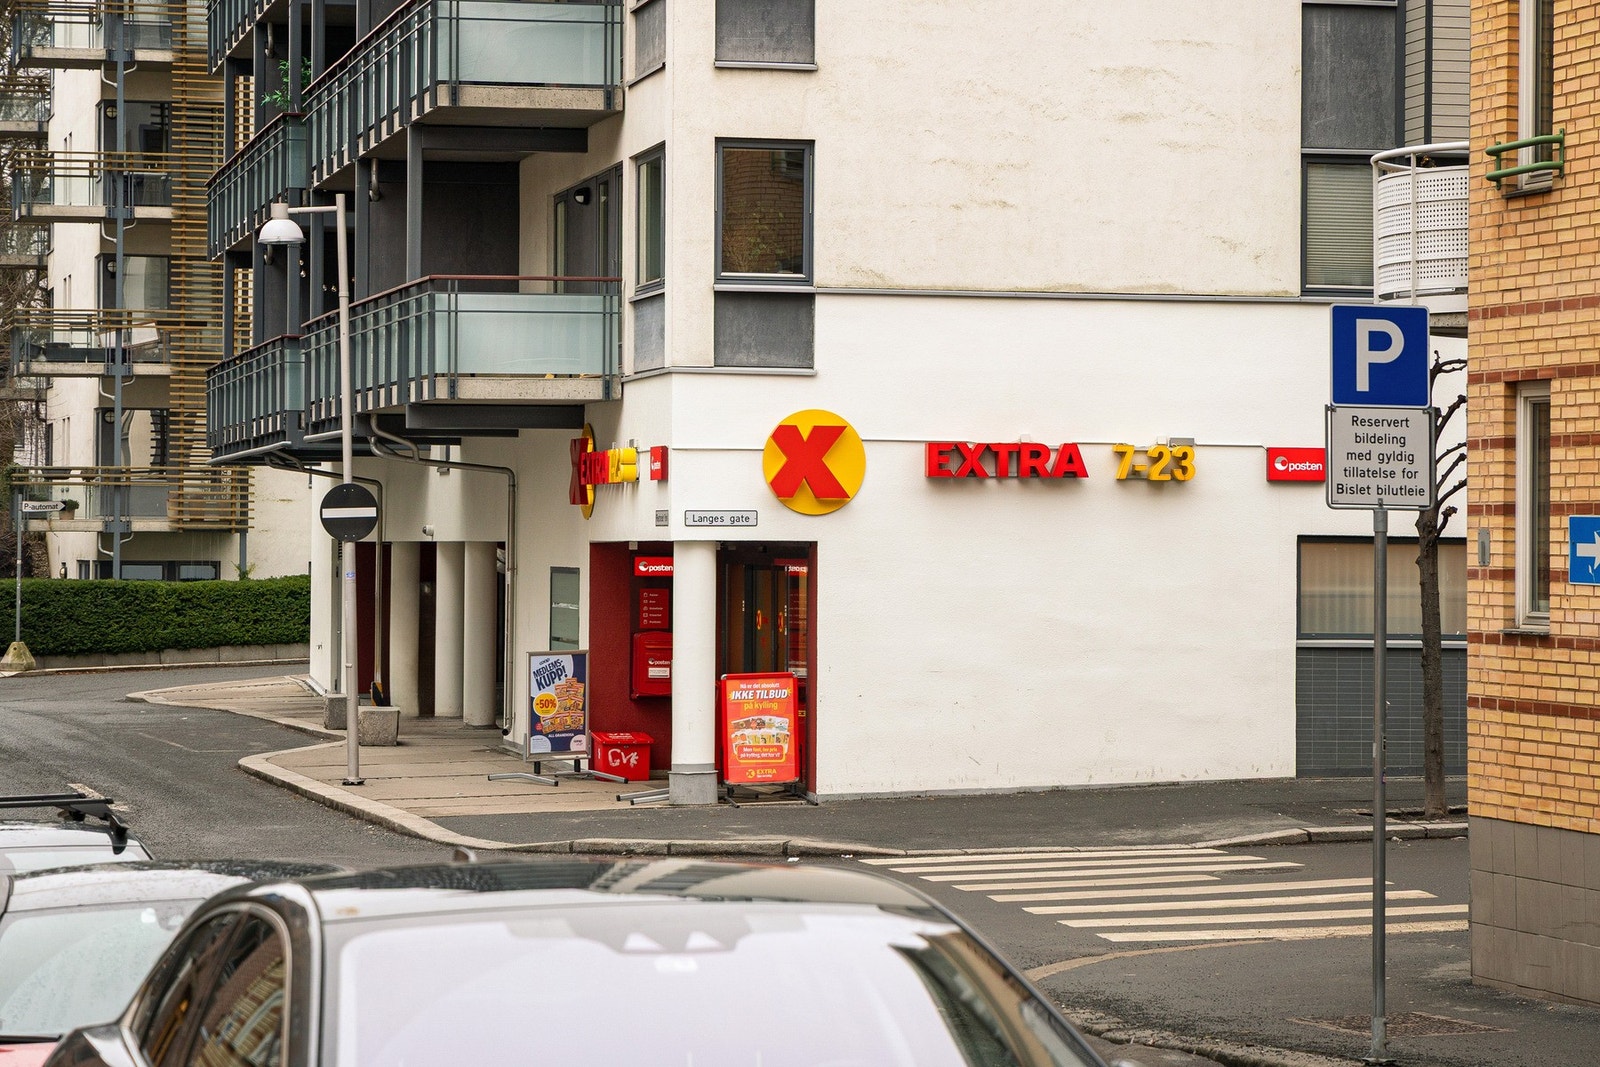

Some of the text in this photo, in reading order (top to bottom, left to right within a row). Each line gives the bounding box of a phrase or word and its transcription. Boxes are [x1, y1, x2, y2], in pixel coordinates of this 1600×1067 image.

[1356, 319, 1404, 392] P
[1352, 415, 1410, 428] Reservert
[1355, 433, 1406, 447] bildeling
[926, 442, 1197, 482] EXTRA 7-23
[1347, 450, 1415, 465] med gyldig
[1289, 460, 1322, 473] posten
[1343, 467, 1419, 479] tillatelse for
[1336, 484, 1425, 496] Bislet bilutleie
[692, 514, 750, 525] Langes gate
[648, 564, 673, 573] posten
[533, 658, 563, 678] MEDLEMS-
[536, 665, 568, 691] KUPP!
[732, 689, 788, 700] IKKE TILBUD
[536, 698, 557, 709] -50%
[754, 701, 778, 710] kylling
